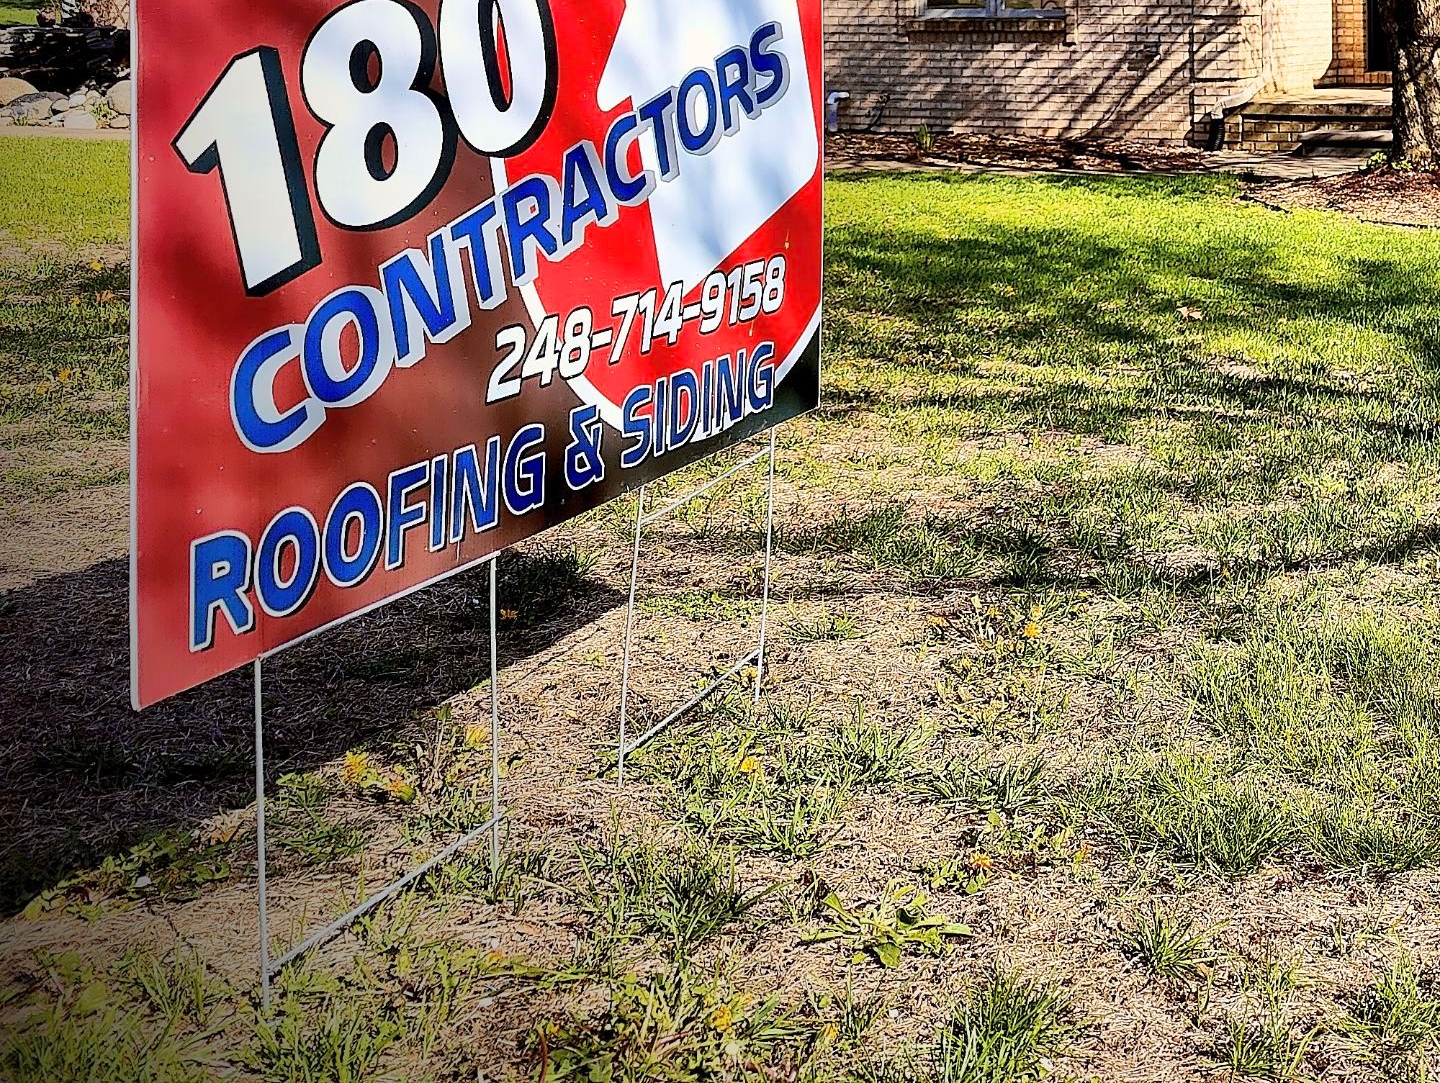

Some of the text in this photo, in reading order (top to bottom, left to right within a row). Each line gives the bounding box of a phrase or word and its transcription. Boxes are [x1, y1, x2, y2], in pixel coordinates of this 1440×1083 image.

[229, 21, 789, 454] CONTRACTORS
[485, 254, 786, 405] 248-714-9158
[188, 341, 775, 653] ROOFING & SIDING
